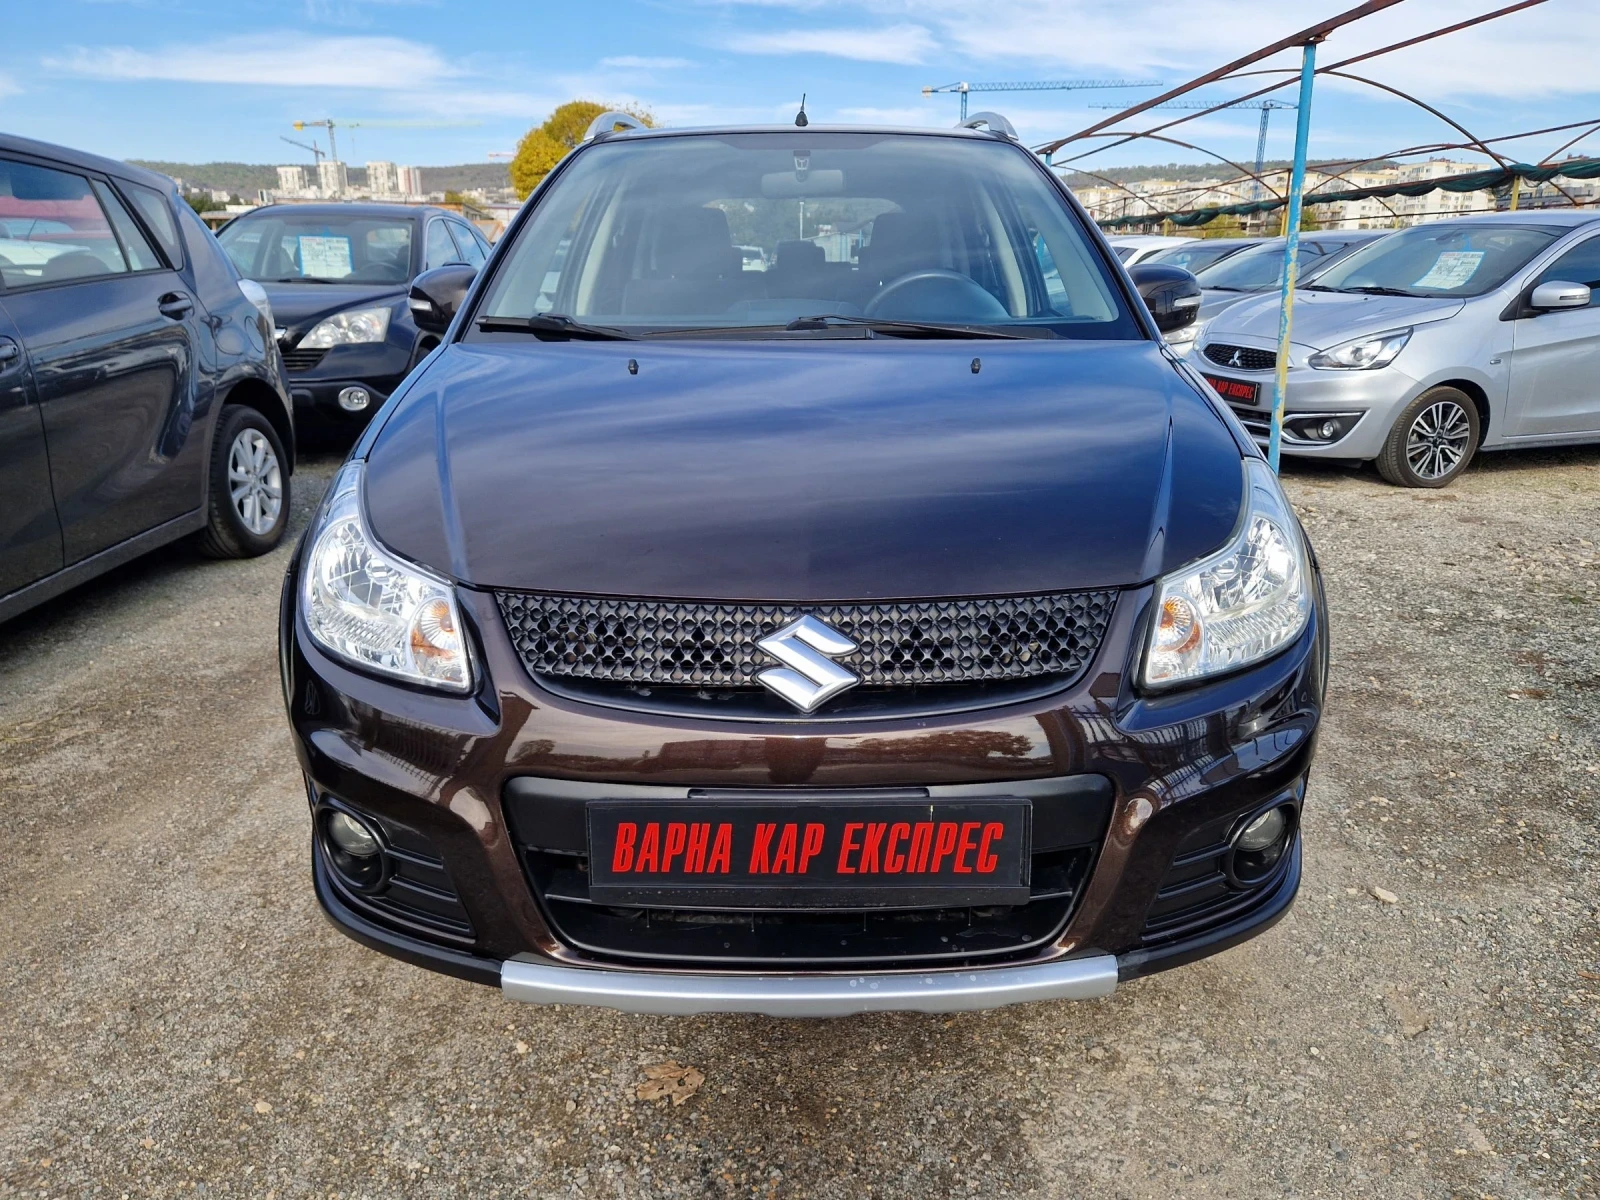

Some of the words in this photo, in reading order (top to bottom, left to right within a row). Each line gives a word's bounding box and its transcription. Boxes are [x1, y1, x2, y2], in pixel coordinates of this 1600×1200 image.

[611, 822, 733, 874] ВАРНА
[748, 822, 826, 874] КАР
[836, 822, 1005, 874] ЕКСПРЕС
